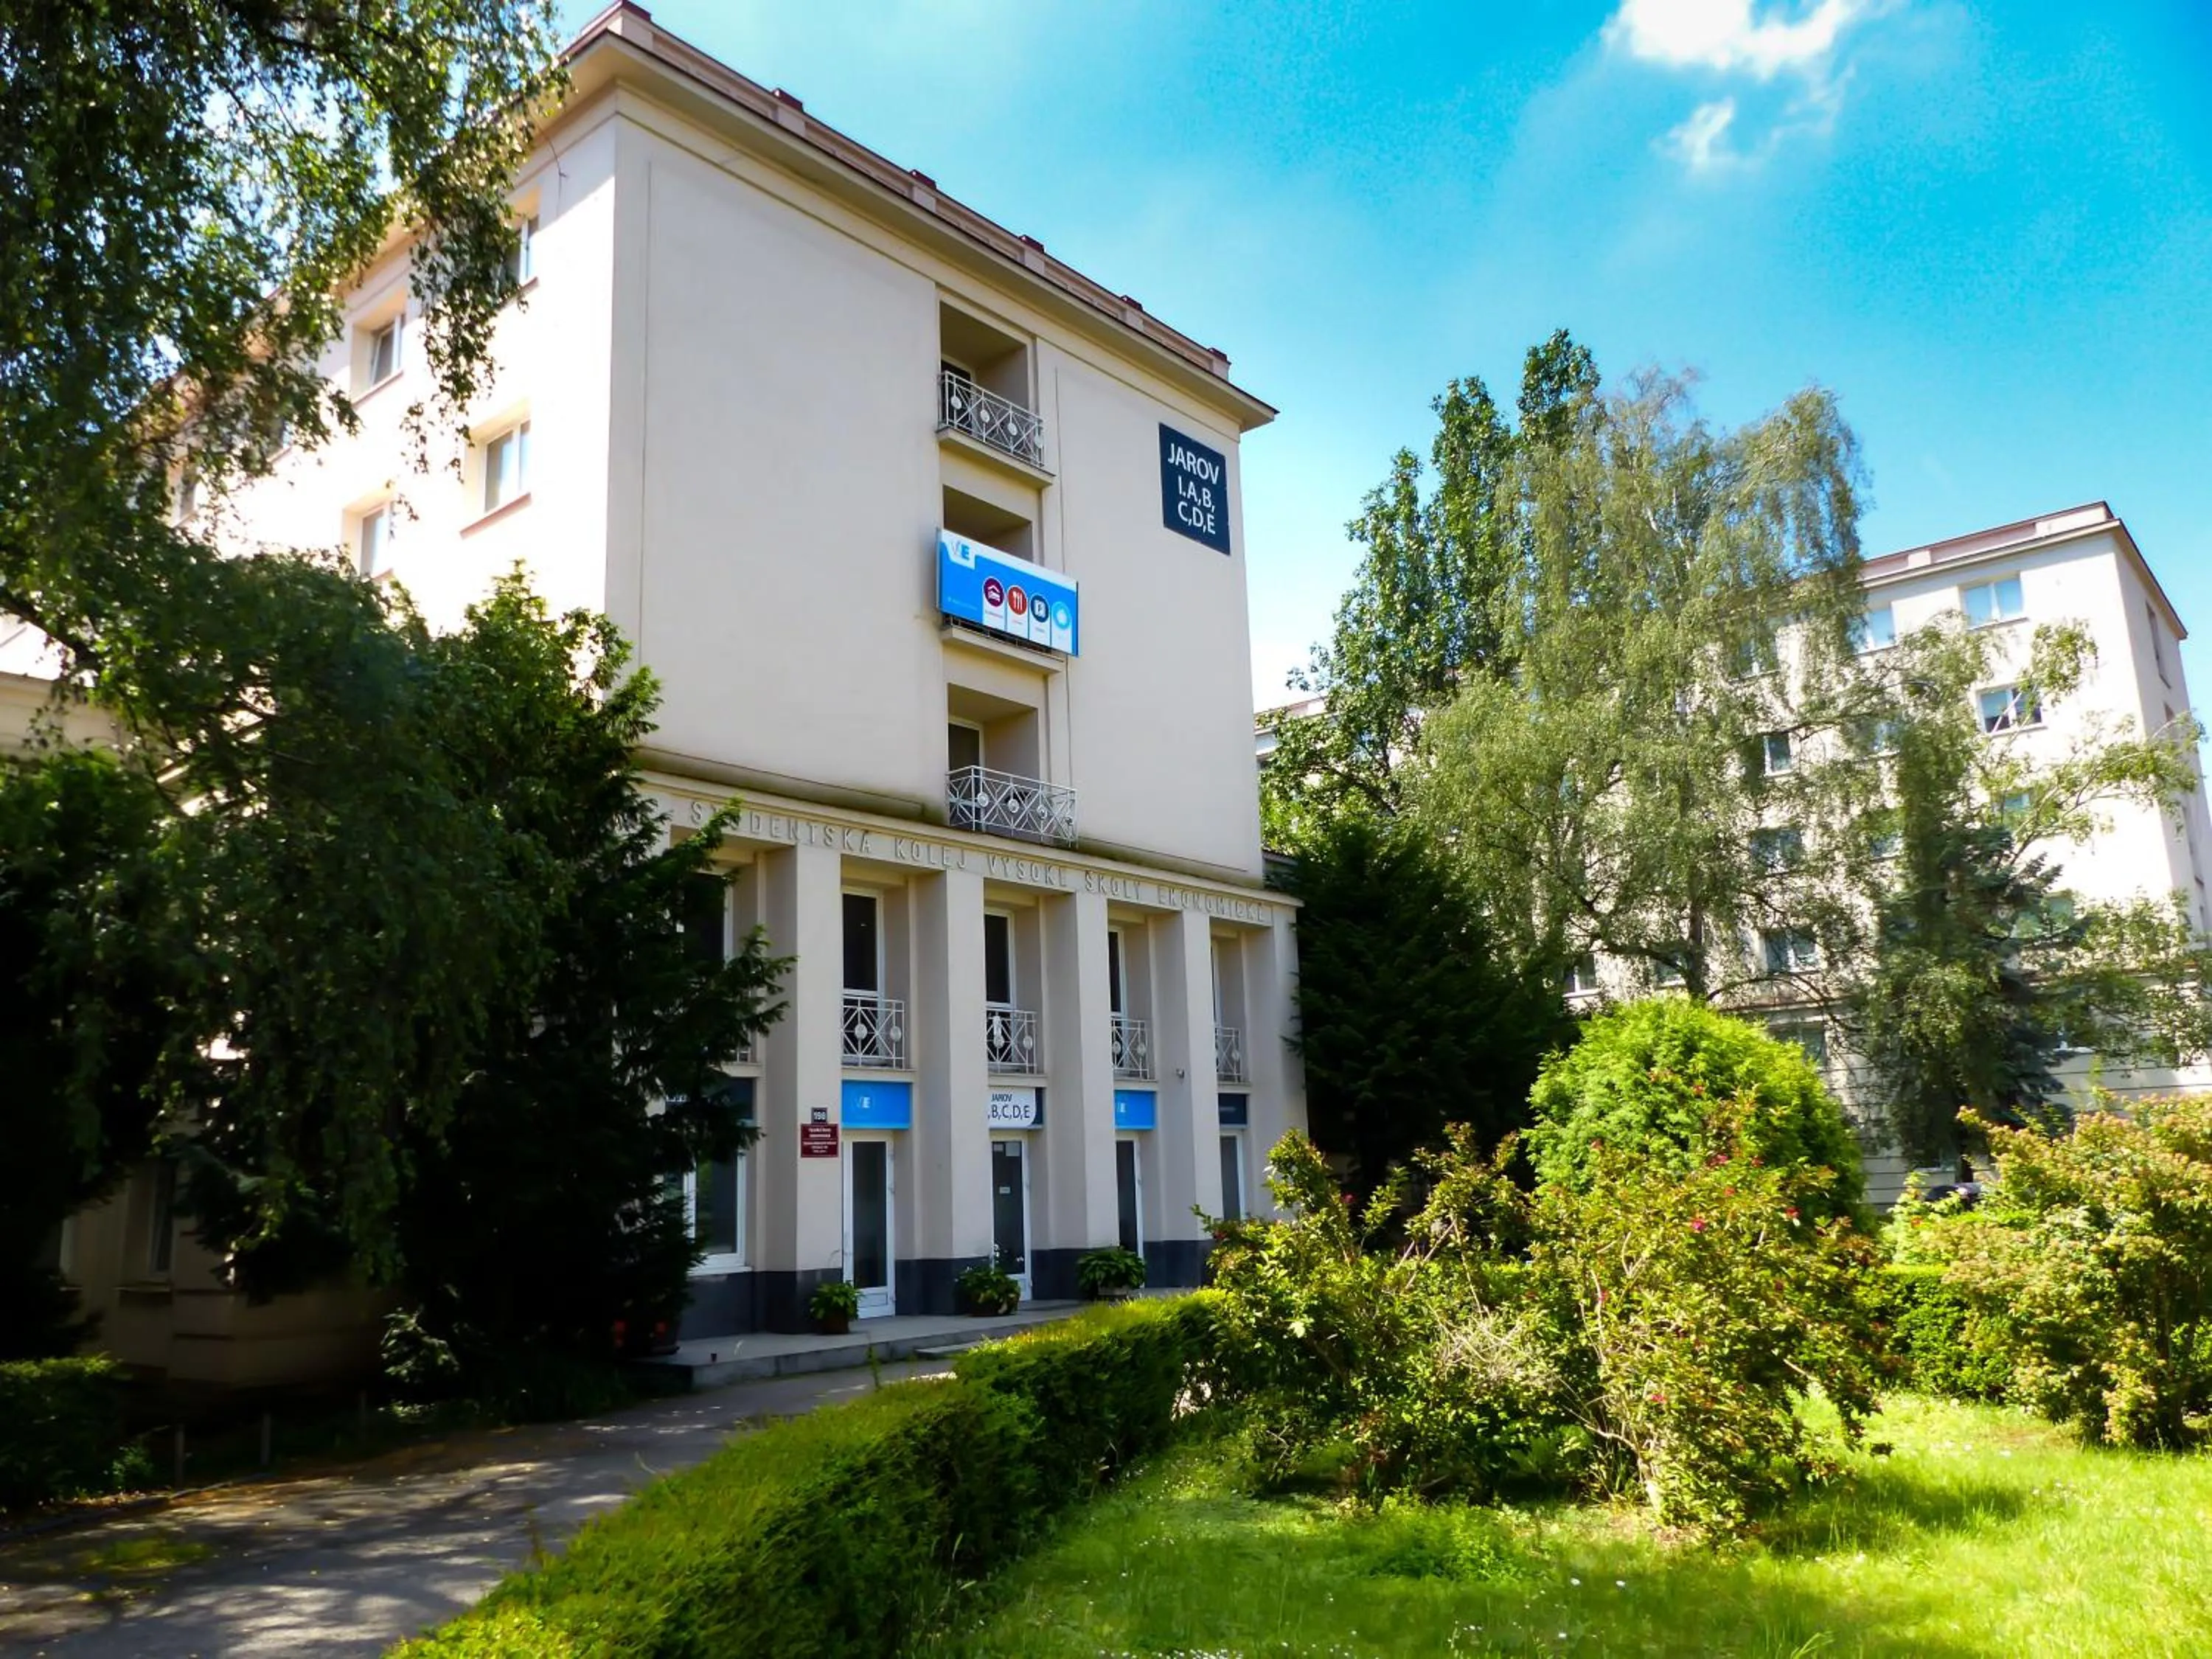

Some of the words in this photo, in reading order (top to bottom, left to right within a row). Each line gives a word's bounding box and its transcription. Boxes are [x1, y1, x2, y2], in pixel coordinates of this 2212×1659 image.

[1168, 443, 1219, 484] JAROV
[1178, 501, 1216, 535] C,D,E
[690, 801, 872, 853] SDENTSKÁ
[894, 836, 967, 869] KOLEJ
